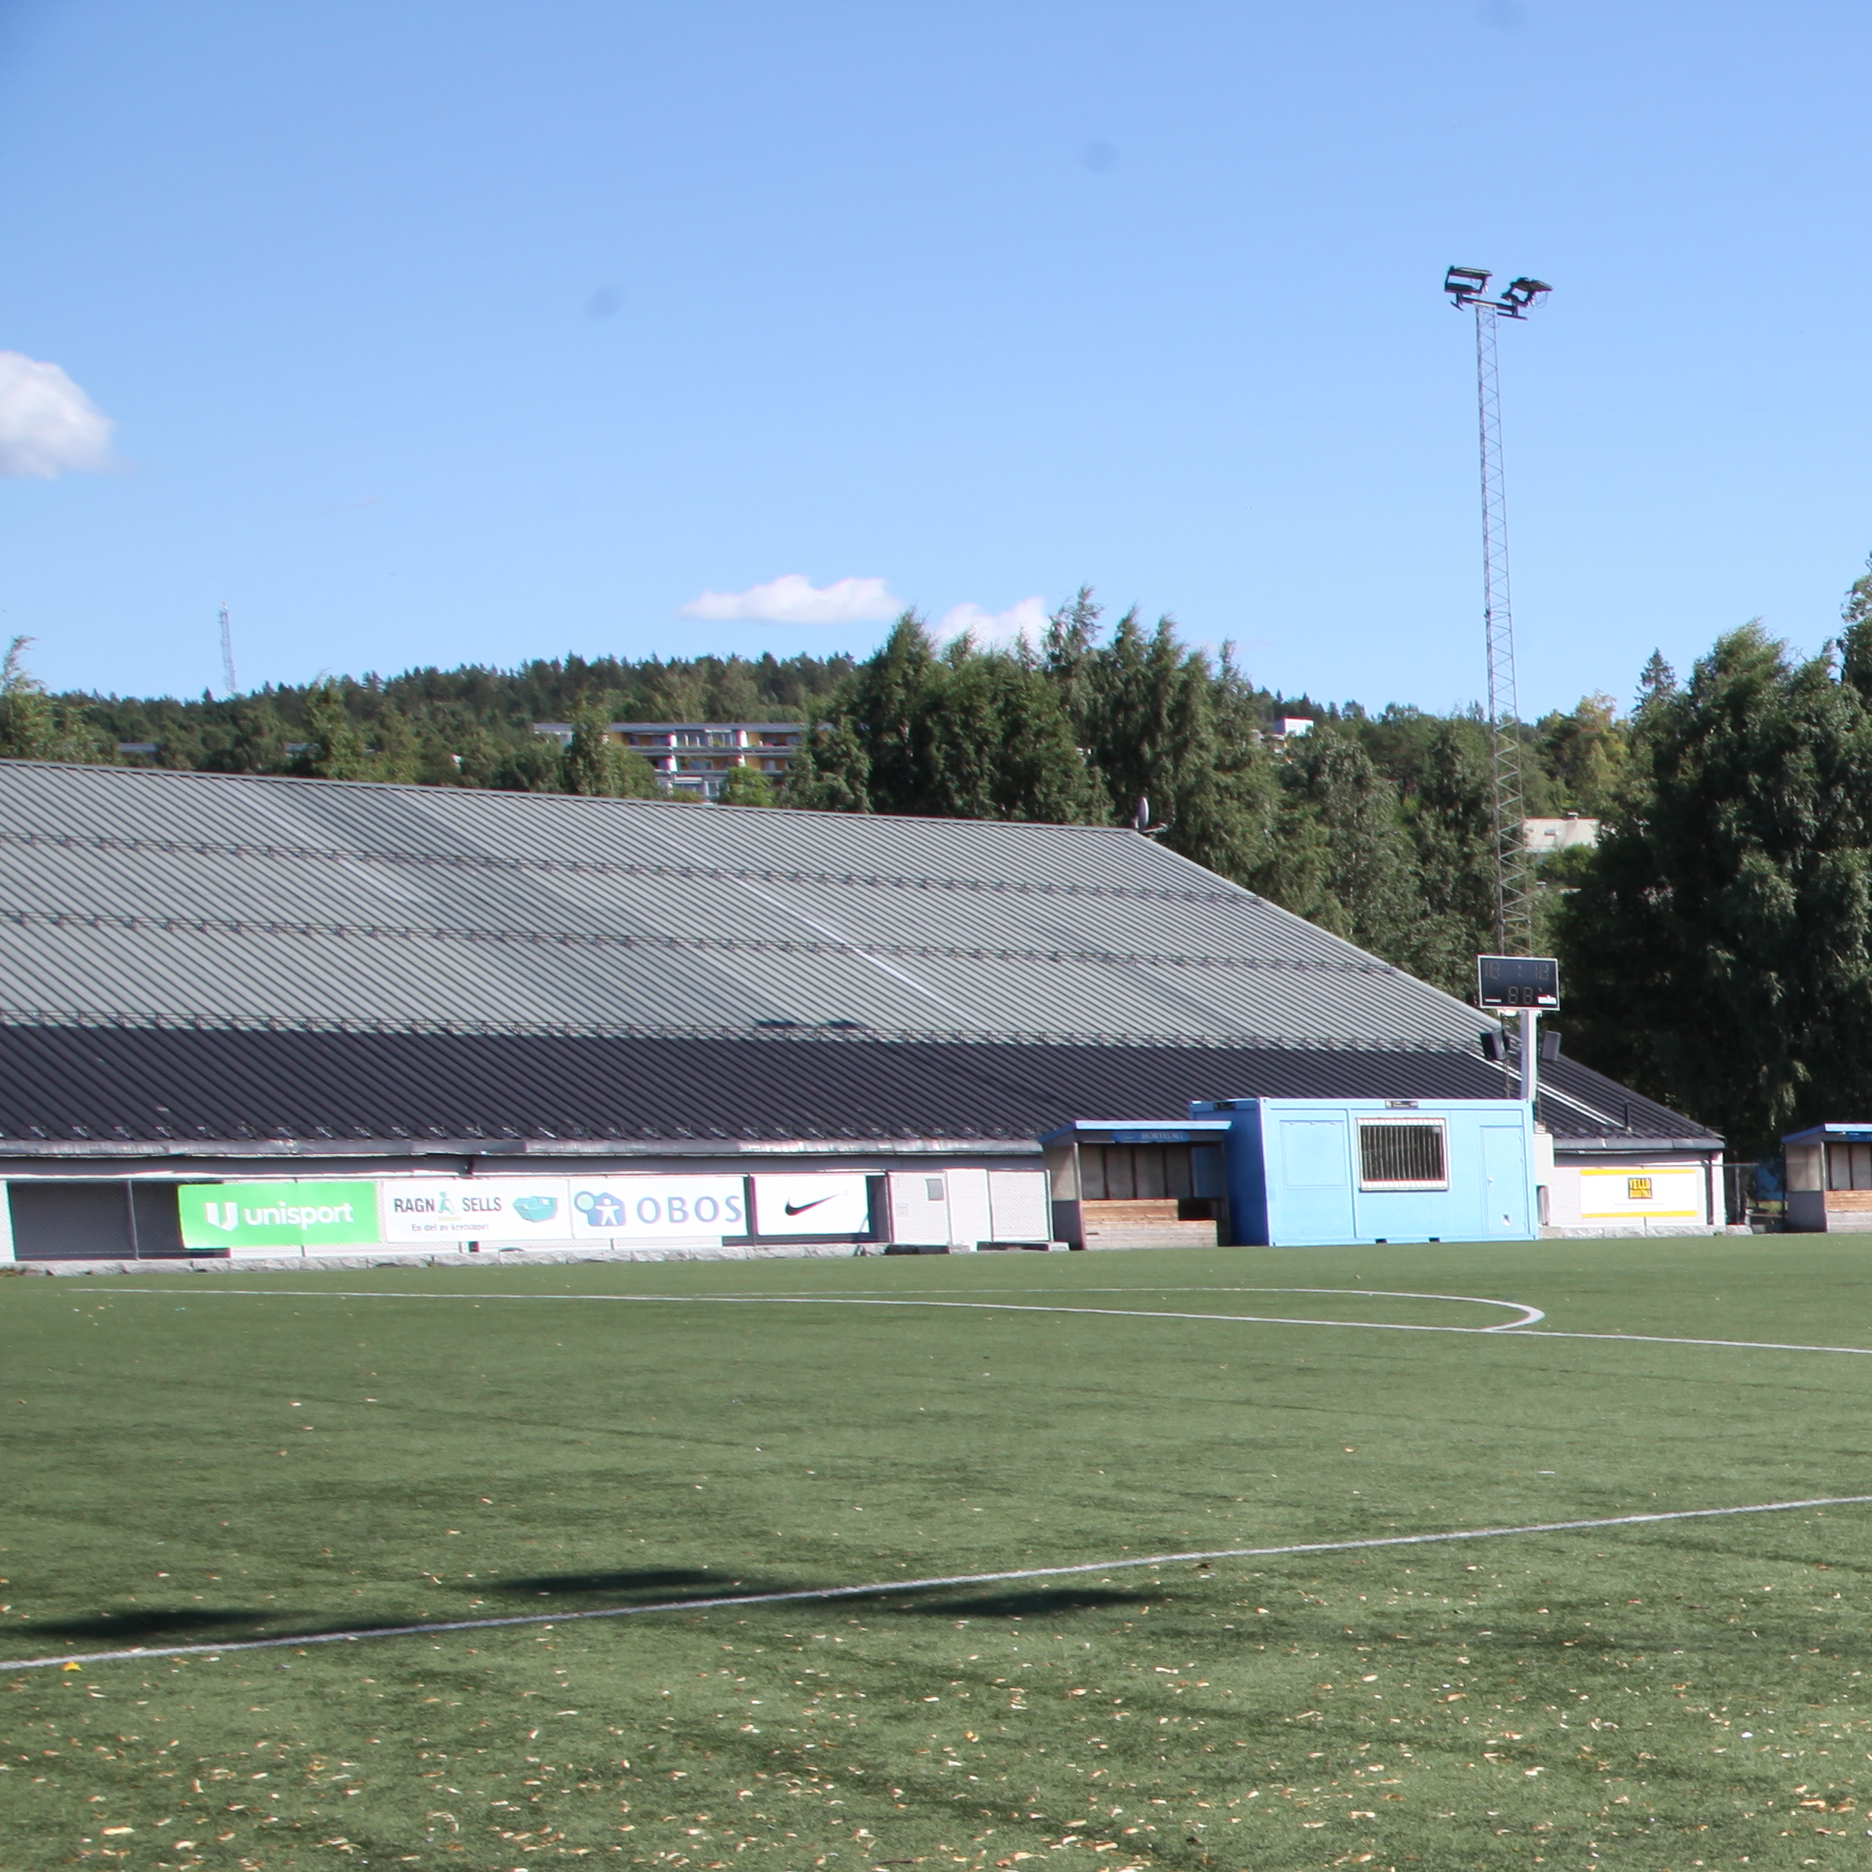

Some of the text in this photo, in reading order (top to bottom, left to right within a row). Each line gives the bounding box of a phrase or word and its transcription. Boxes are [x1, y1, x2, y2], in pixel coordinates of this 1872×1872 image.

[243, 1200, 355, 1231] unisport
[393, 1196, 502, 1213] RAGN SELLS
[637, 1195, 742, 1224] OBOS
[424, 1223, 437, 1232] del
